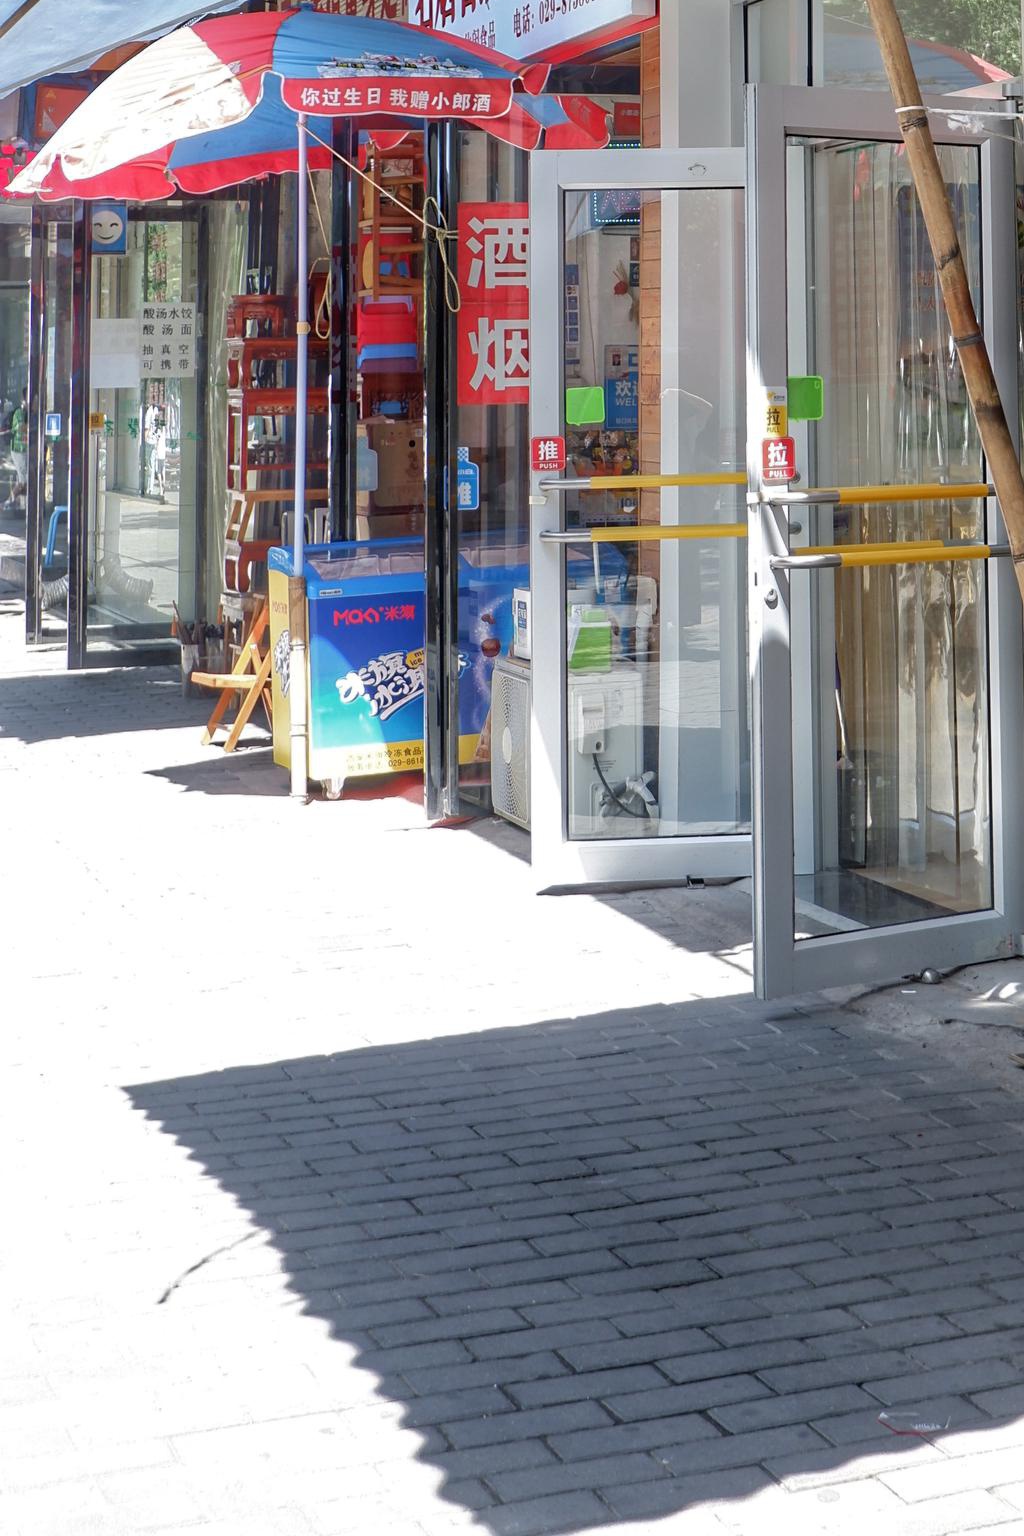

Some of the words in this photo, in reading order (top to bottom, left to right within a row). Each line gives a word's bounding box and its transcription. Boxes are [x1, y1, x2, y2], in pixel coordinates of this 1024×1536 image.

[300, 87, 381, 107] 你过生日
[389, 88, 492, 112] 我赠小郎酒
[143, 308, 193, 319] 酸汤水饺
[767, 408, 780, 425] 拉
[538, 440, 558, 460] 推
[767, 442, 788, 466] 拉
